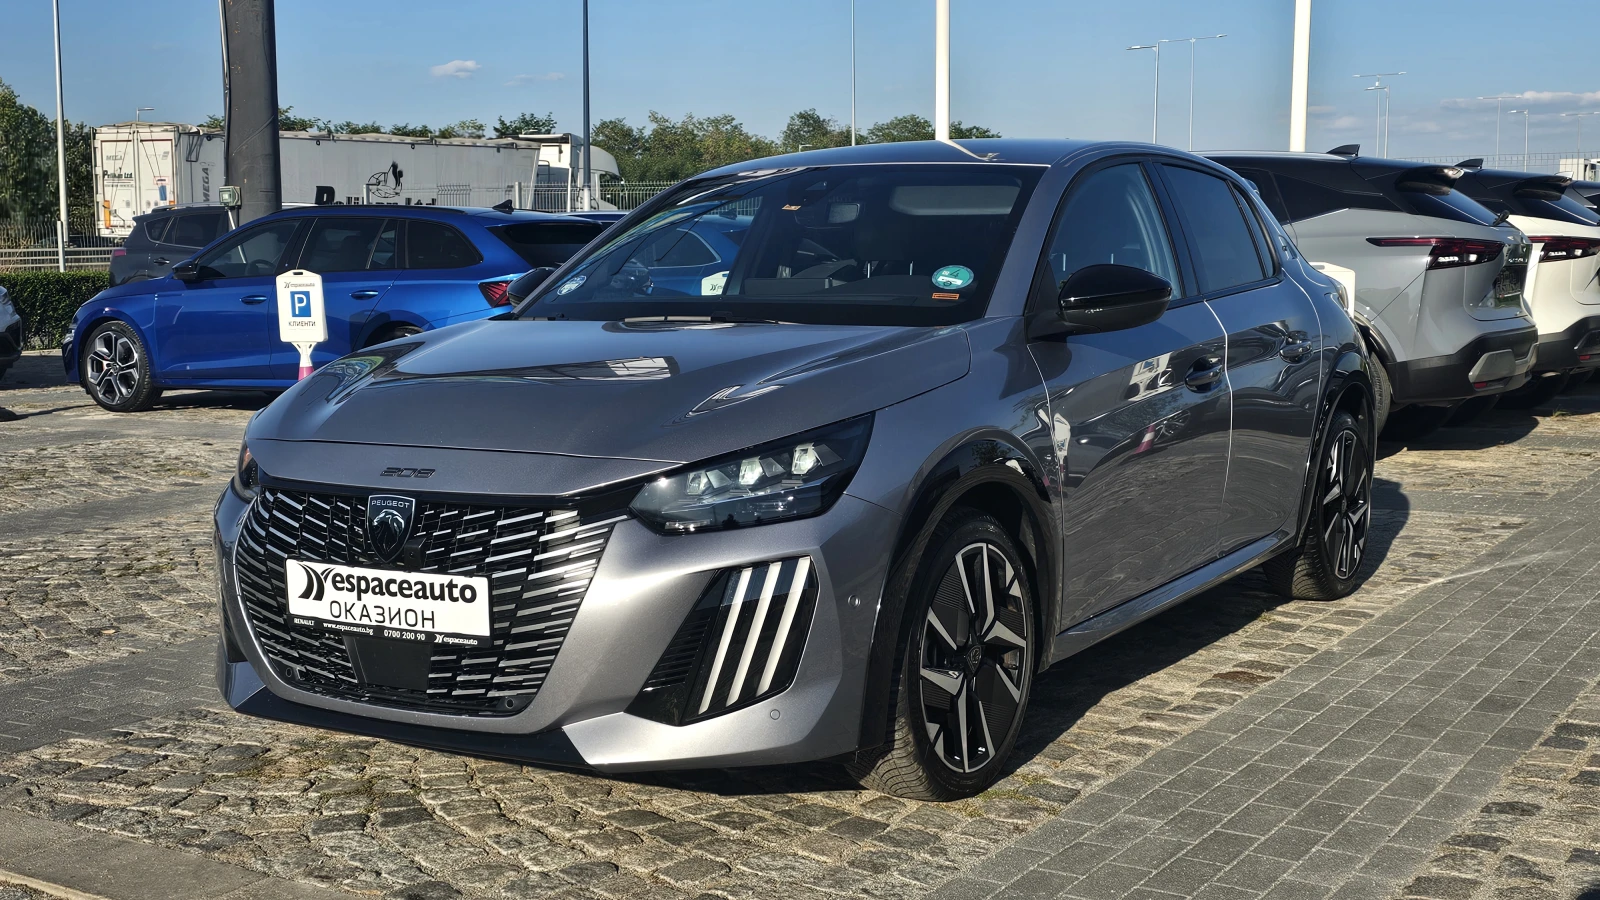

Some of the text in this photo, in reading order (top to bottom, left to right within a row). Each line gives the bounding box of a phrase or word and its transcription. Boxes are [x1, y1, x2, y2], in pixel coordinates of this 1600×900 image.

[294, 294, 307, 315] P
[380, 467, 436, 479] 208
[371, 500, 410, 508] PEUGEOT
[331, 572, 478, 604] espaceauto
[330, 600, 435, 629] ОКАЗИОН
[293, 618, 315, 626] RENAULT
[322, 622, 374, 636] www.espaceauto.bg
[384, 629, 425, 641] 0700 200 90
[443, 637, 478, 645] espaceauto
